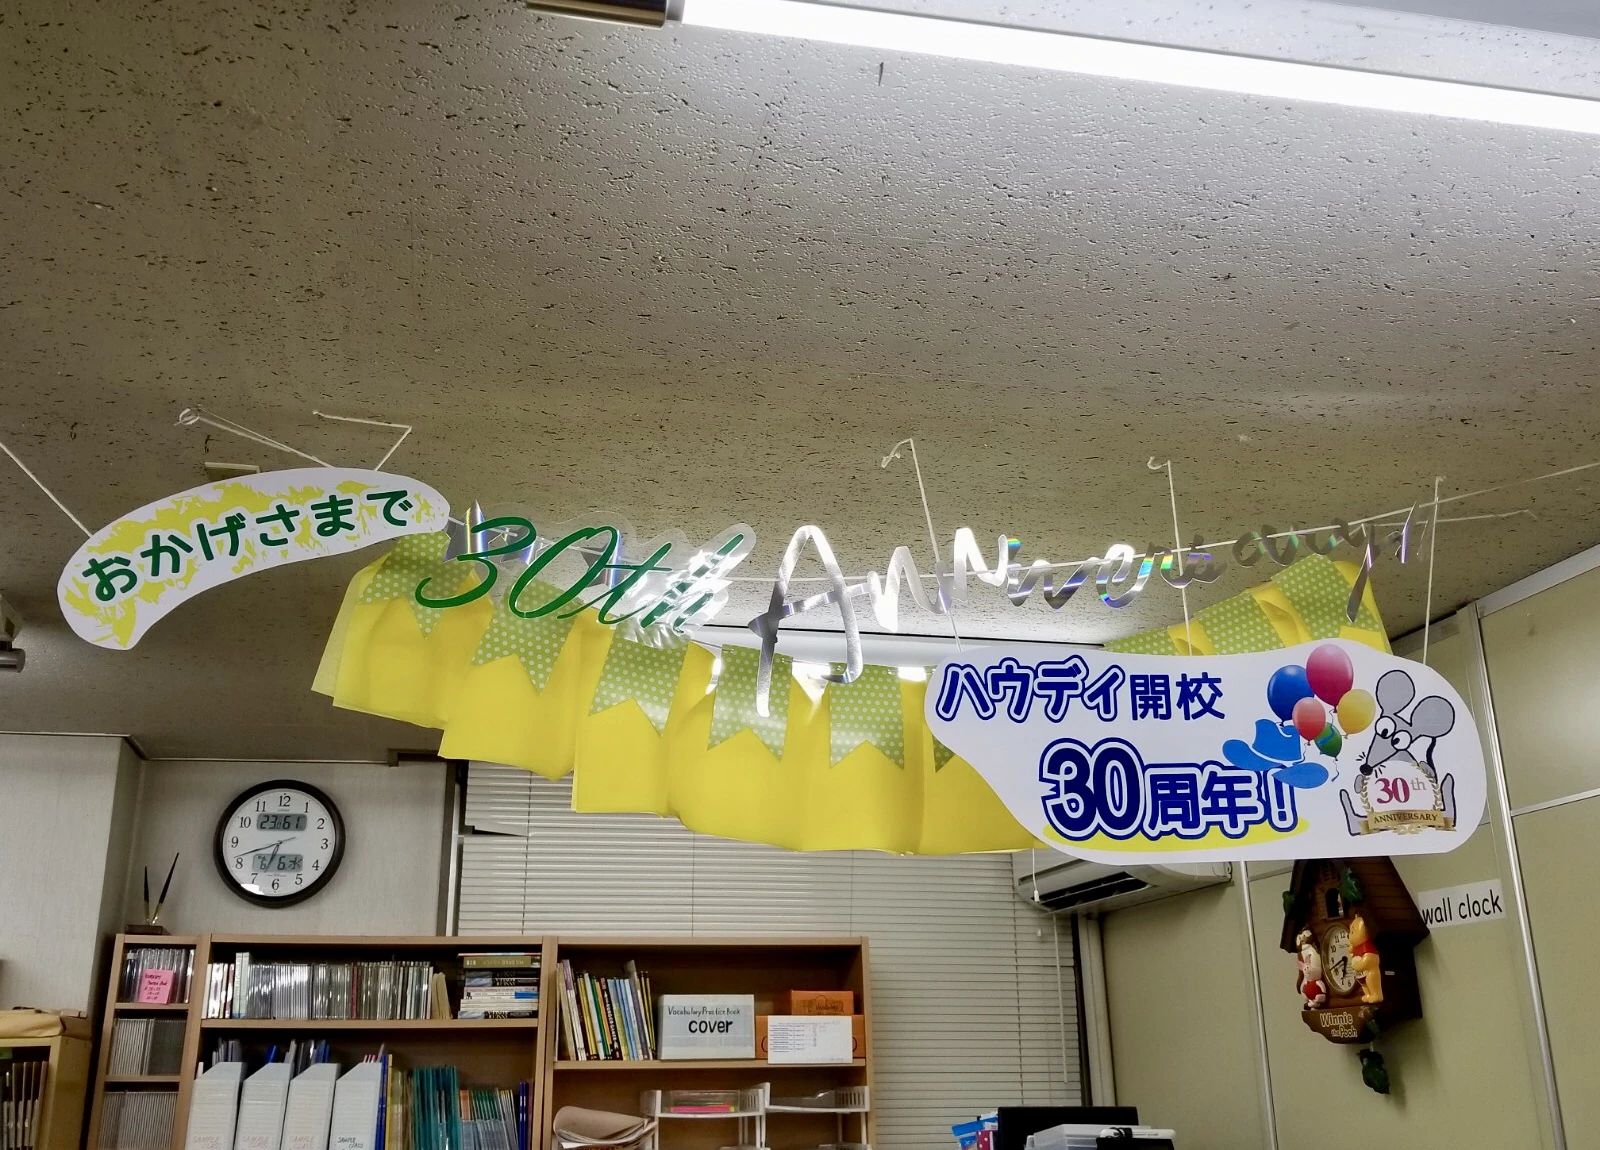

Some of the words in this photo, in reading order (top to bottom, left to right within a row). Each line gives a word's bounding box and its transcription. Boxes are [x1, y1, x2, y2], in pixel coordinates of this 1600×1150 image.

[82, 490, 413, 601] おかげさまで
[1375, 777, 1426, 804] 30th
[256, 801, 266, 812] 11
[279, 795, 291, 807] 12
[304, 802, 309, 813] 1
[240, 817, 251, 828] 10
[317, 818, 325, 829] 2
[1374, 814, 1438, 824] ANNIVERSARY
[231, 836, 239, 848] 9
[320, 838, 329, 849] 3
[235, 857, 243, 869] 8
[312, 860, 319, 871] 4
[251, 873, 258, 884] 7
[271, 878, 279, 890] 6
[295, 873, 303, 885] 5
[1422, 897, 1452, 925] wall
[1458, 889, 1502, 919] clock
[668, 1006, 700, 1017] Vocabulary
[727, 1007, 740, 1015] Book
[1320, 1012, 1354, 1027] Winnie
[688, 1020, 734, 1034] cover
[1339, 1025, 1358, 1038] Pooh
